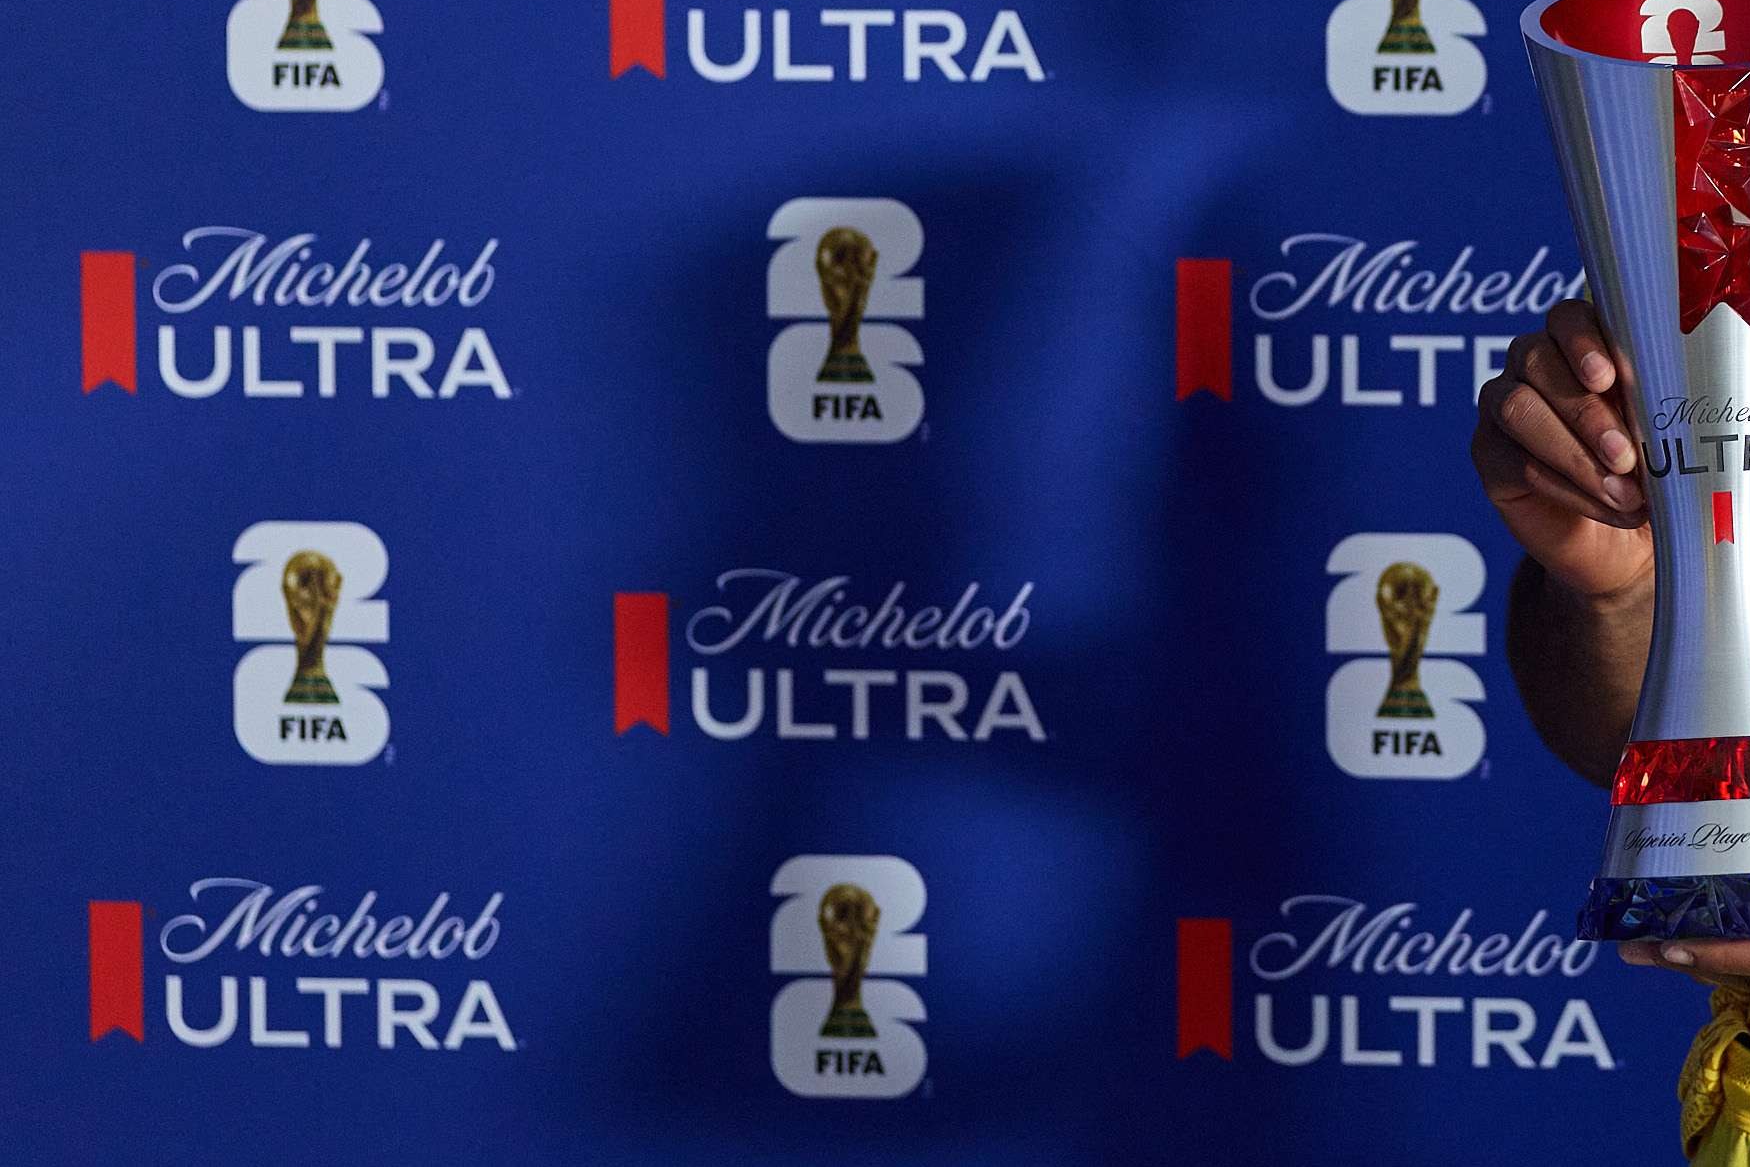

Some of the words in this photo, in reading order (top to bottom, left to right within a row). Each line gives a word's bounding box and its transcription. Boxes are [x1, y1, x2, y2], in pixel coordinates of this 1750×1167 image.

[274, 64, 340, 87] FIFA
[688, 9, 1045, 82] ULTRA
[1374, 67, 1443, 91] FIFA
[153, 227, 498, 313] Michelob
[158, 325, 512, 399] ULTRA
[813, 395, 882, 420] FIFA
[687, 569, 1035, 654] Michelob
[280, 717, 346, 741] FIFA
[691, 667, 1046, 741] ULTRA
[1372, 731, 1441, 756] FIFA
[160, 878, 503, 963] Michelob
[166, 975, 516, 1050] ULTRA
[1254, 994, 1616, 1070] ULTRA
[816, 1050, 884, 1075] FIFA
